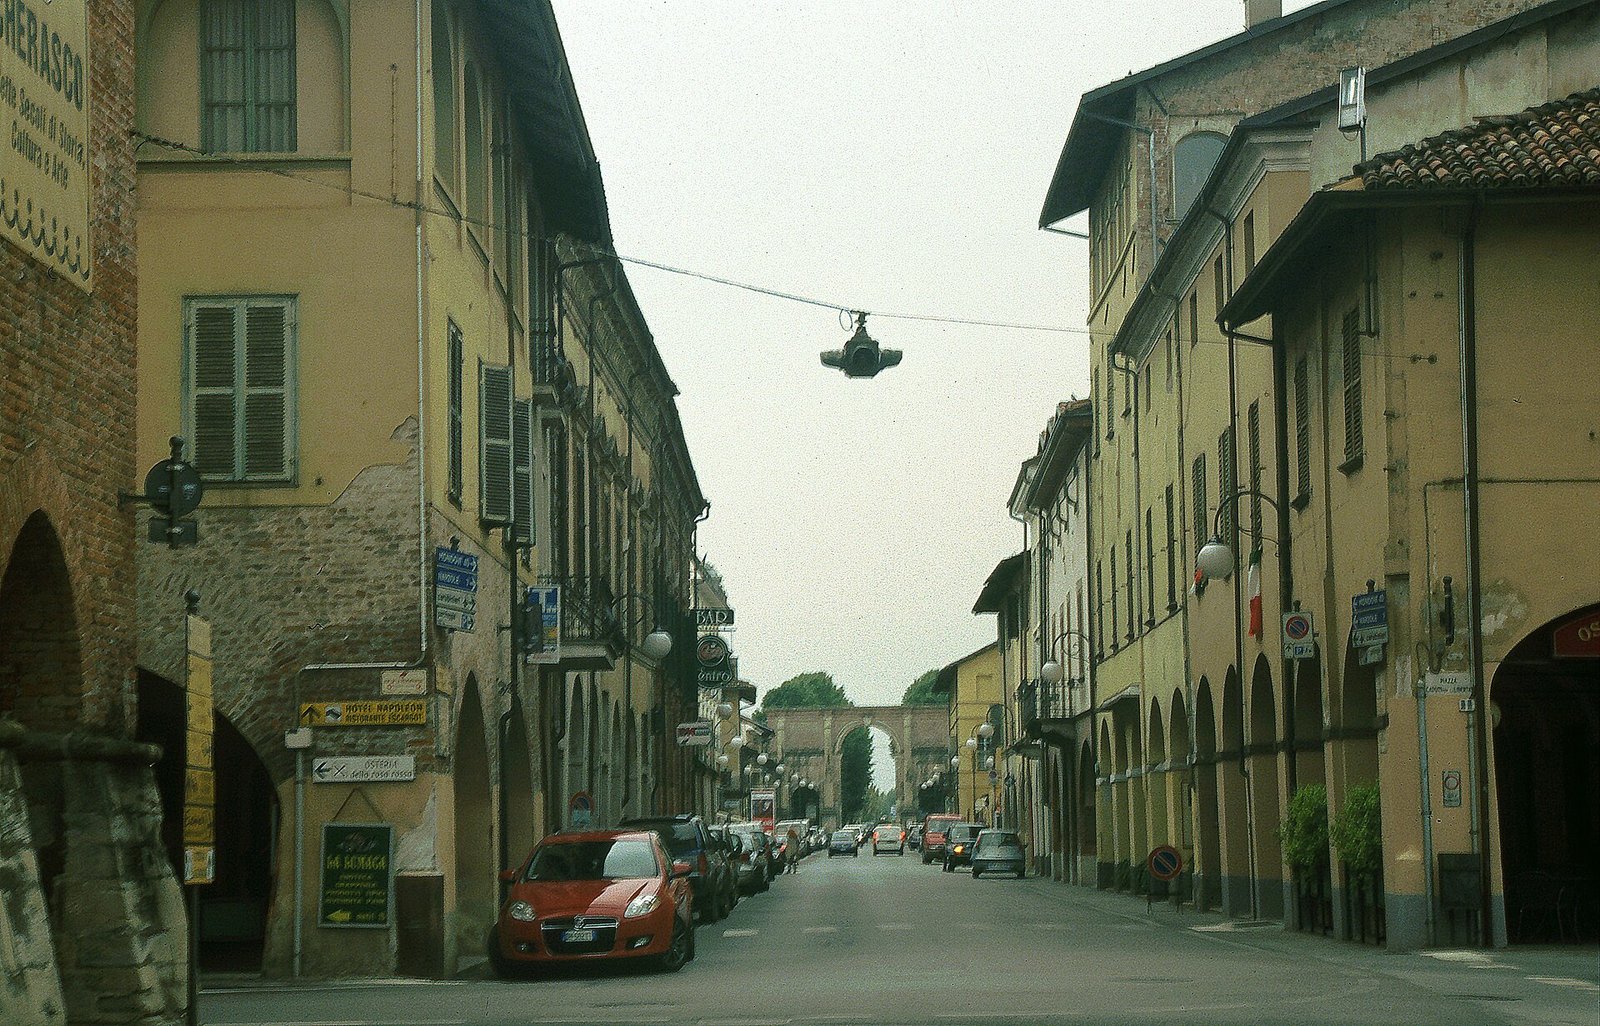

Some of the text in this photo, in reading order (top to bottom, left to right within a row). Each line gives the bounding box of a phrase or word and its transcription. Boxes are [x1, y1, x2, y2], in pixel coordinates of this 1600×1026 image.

[0, 0, 83, 112] HERASCO
[19, 87, 46, 136] Secoli
[11, 119, 68, 190] Cultura e Arte
[696, 611, 728, 625] BAR
[345, 703, 422, 713] HOTEL NAPOLEON
[345, 713, 422, 723] RISTORANTE ESCARGOT
[364, 760, 397, 769] OSTERIA
